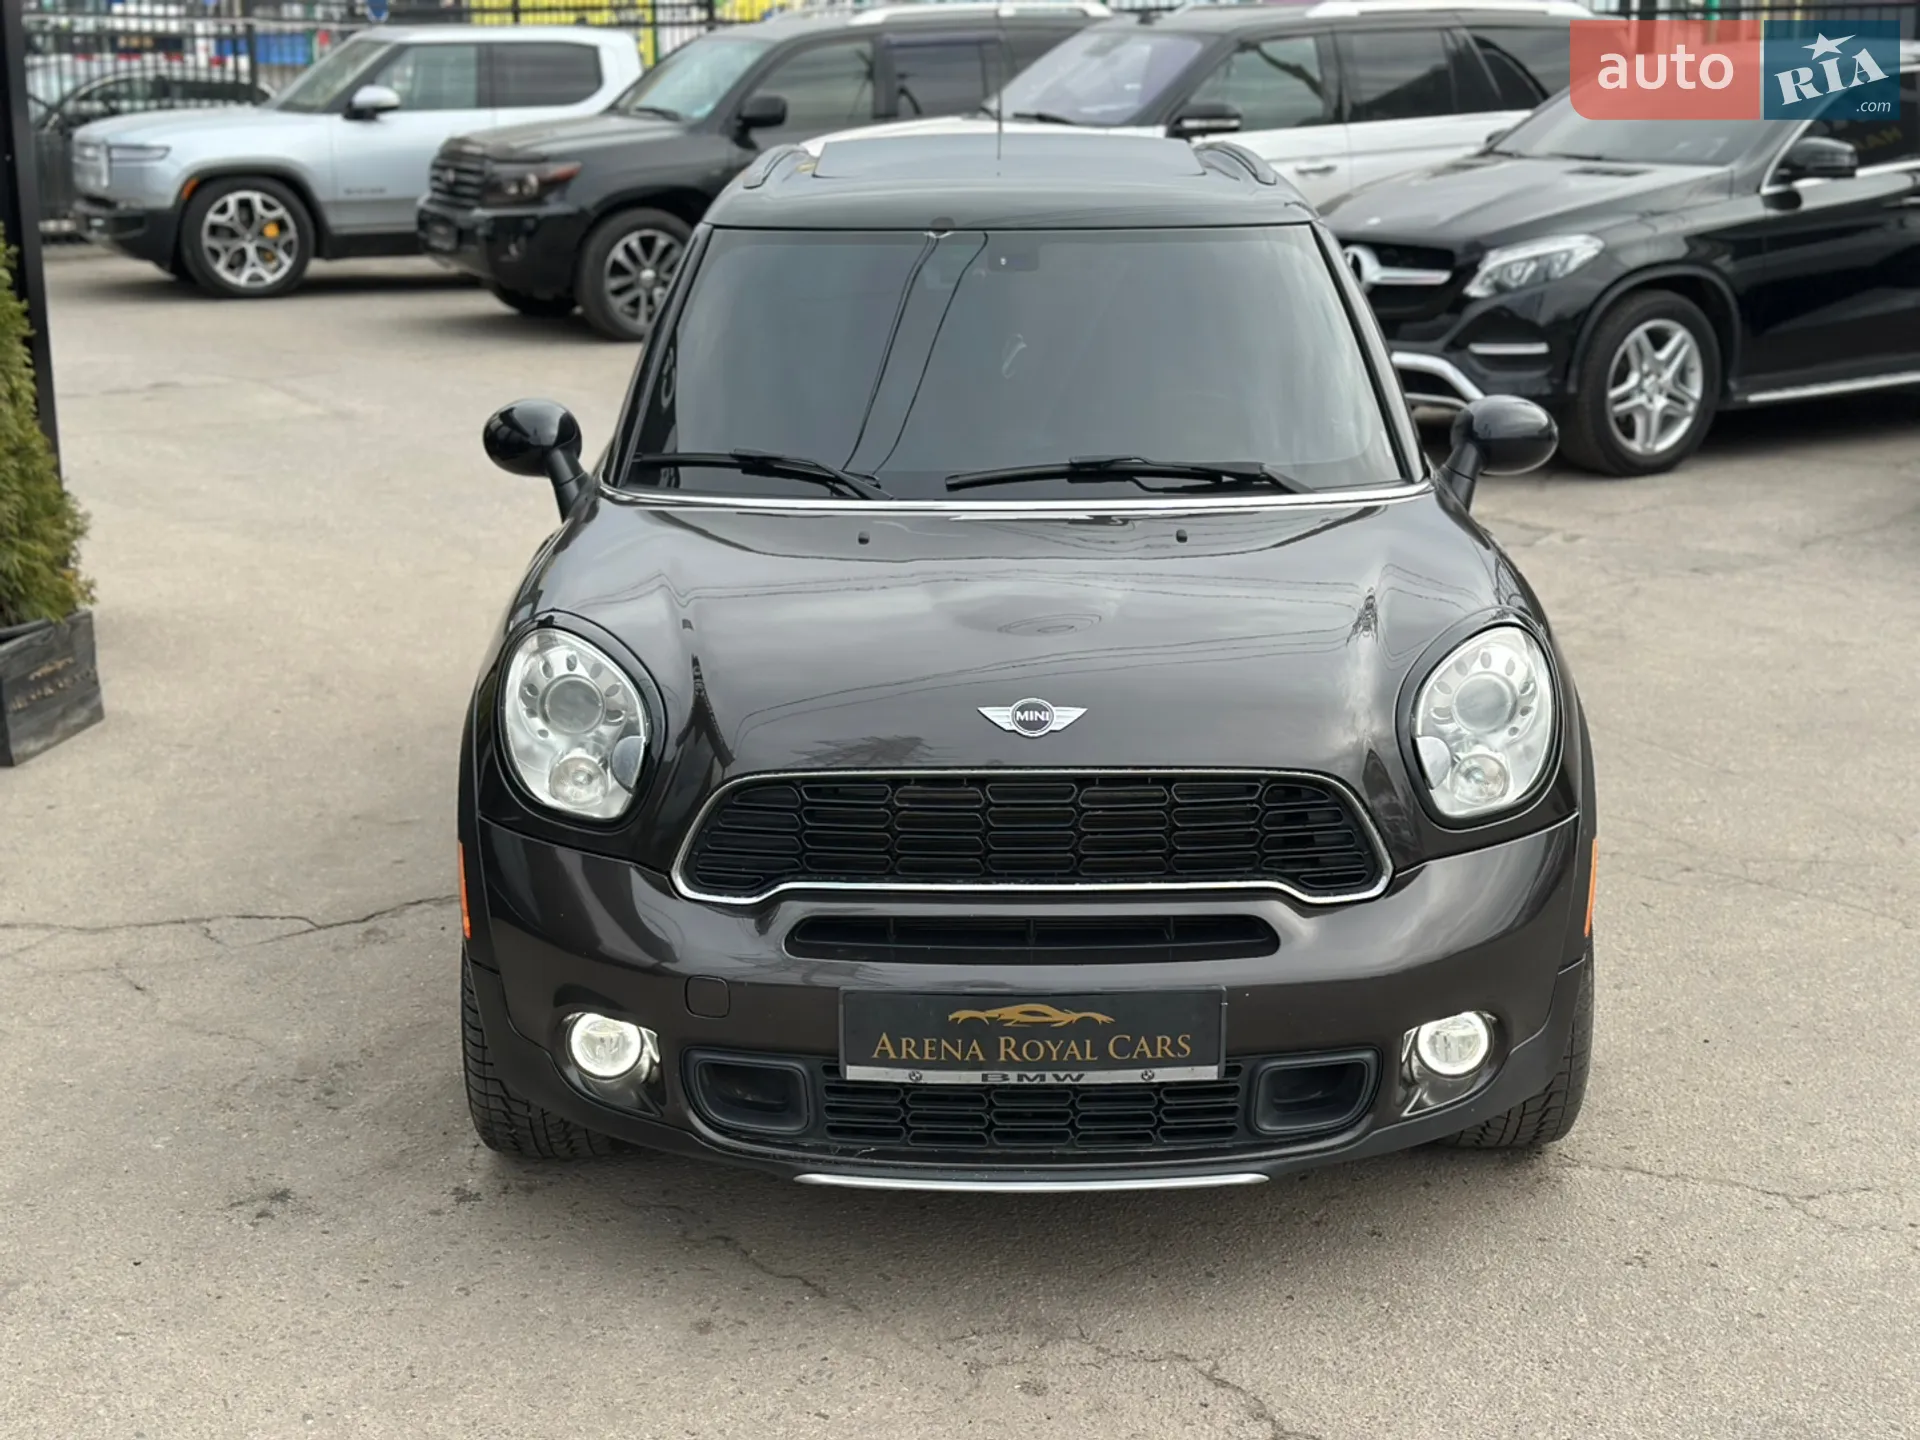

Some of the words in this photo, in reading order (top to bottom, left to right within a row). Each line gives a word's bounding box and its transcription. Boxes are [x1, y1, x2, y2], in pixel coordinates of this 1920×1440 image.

[1016, 710, 1049, 721] MINI
[871, 1032, 986, 1061] ARENA
[997, 1035, 1098, 1062] ROYAL
[1108, 1034, 1191, 1060] CARS
[981, 1073, 1085, 1082] BMW
